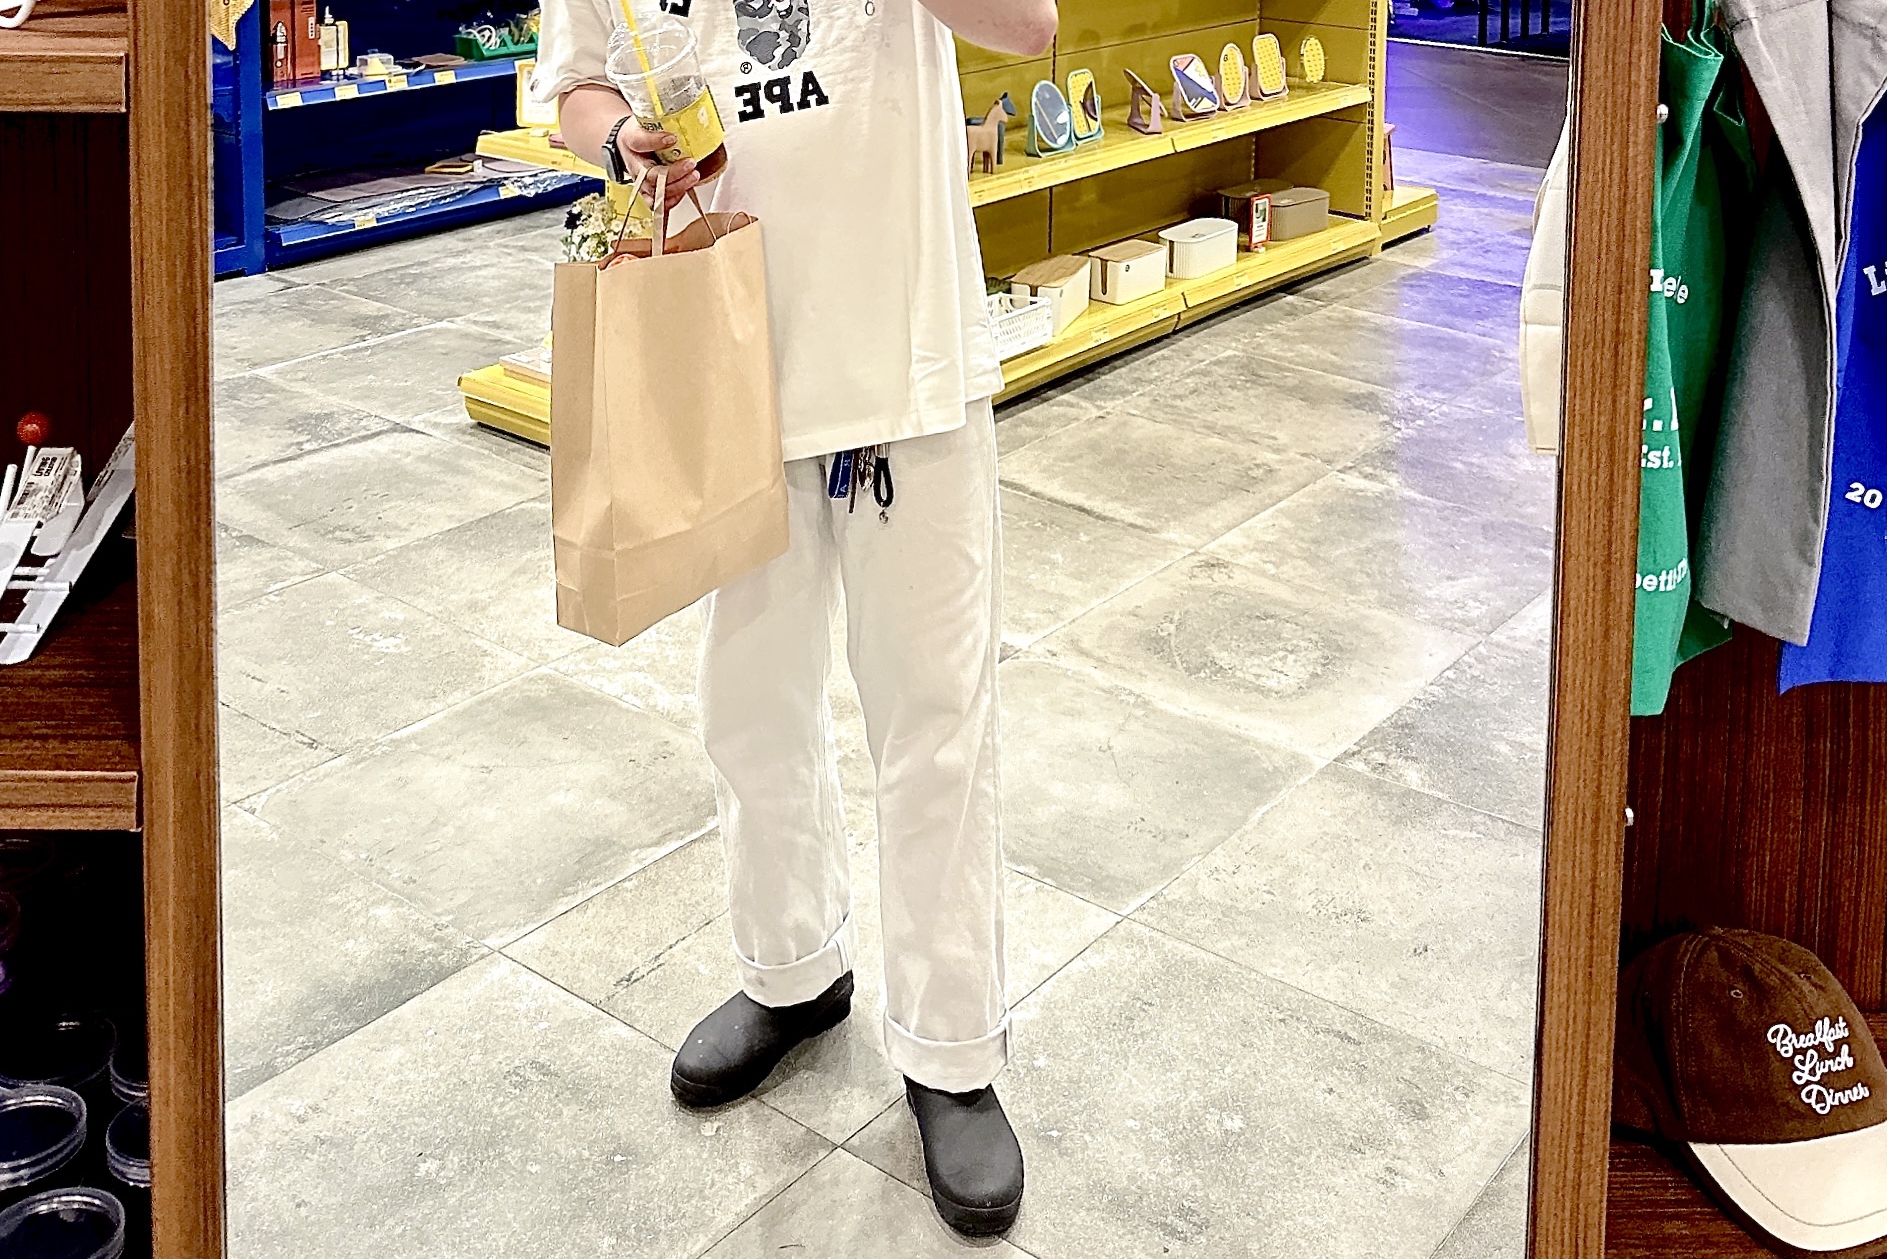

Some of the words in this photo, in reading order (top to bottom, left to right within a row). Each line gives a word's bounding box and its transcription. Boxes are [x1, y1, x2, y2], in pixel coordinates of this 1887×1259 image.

[1862, 261, 1887, 296] L
[1791, 1044, 1854, 1085] Lunch
[1801, 1082, 1870, 1115] Dinner
